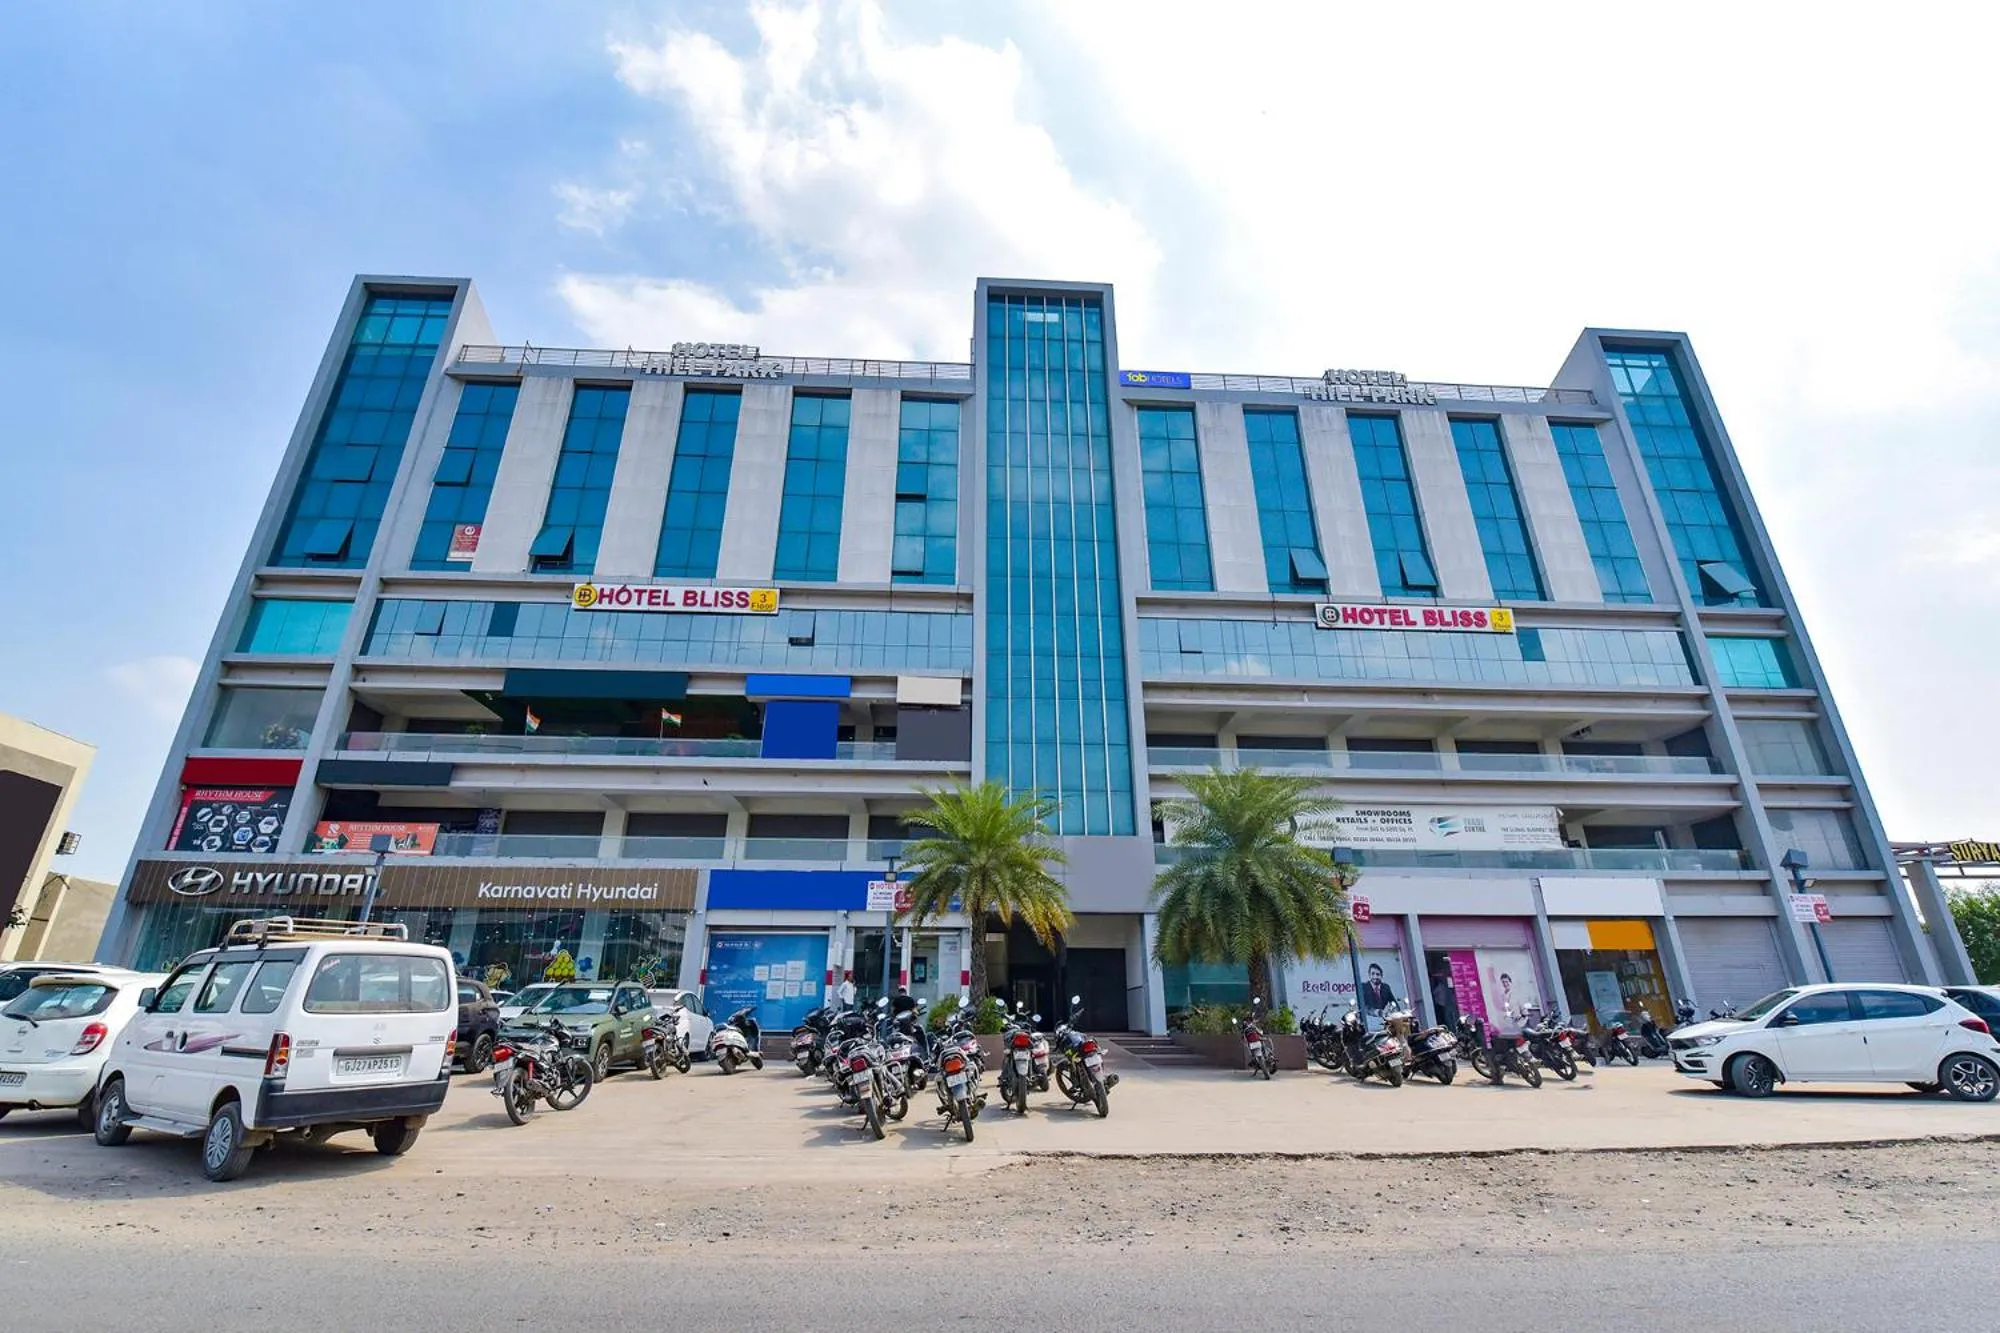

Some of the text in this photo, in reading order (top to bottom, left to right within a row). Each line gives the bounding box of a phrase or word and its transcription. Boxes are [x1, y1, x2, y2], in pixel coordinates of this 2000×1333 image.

[672, 343, 759, 359] HOTEL
[643, 359, 784, 379] HILL PARK
[1326, 369, 1407, 386] HOTEL
[1304, 386, 1436, 405] HILL PARK
[599, 586, 675, 607] HOTEL
[682, 590, 750, 609] BLISS
[760, 593, 767, 603] 3
[1341, 607, 1418, 627] HOTEL
[1422, 609, 1488, 628] BLISS
[195, 789, 234, 798] RHYTHM
[235, 790, 265, 799] HOUSE
[1335, 816, 1370, 824] RETAILS
[1355, 810, 1412, 818] SHOWROOMS
[1949, 841, 2000, 862] SURYA
[230, 872, 371, 896] HYUNDAI
[478, 882, 659, 902] Karnavati Hyundai
